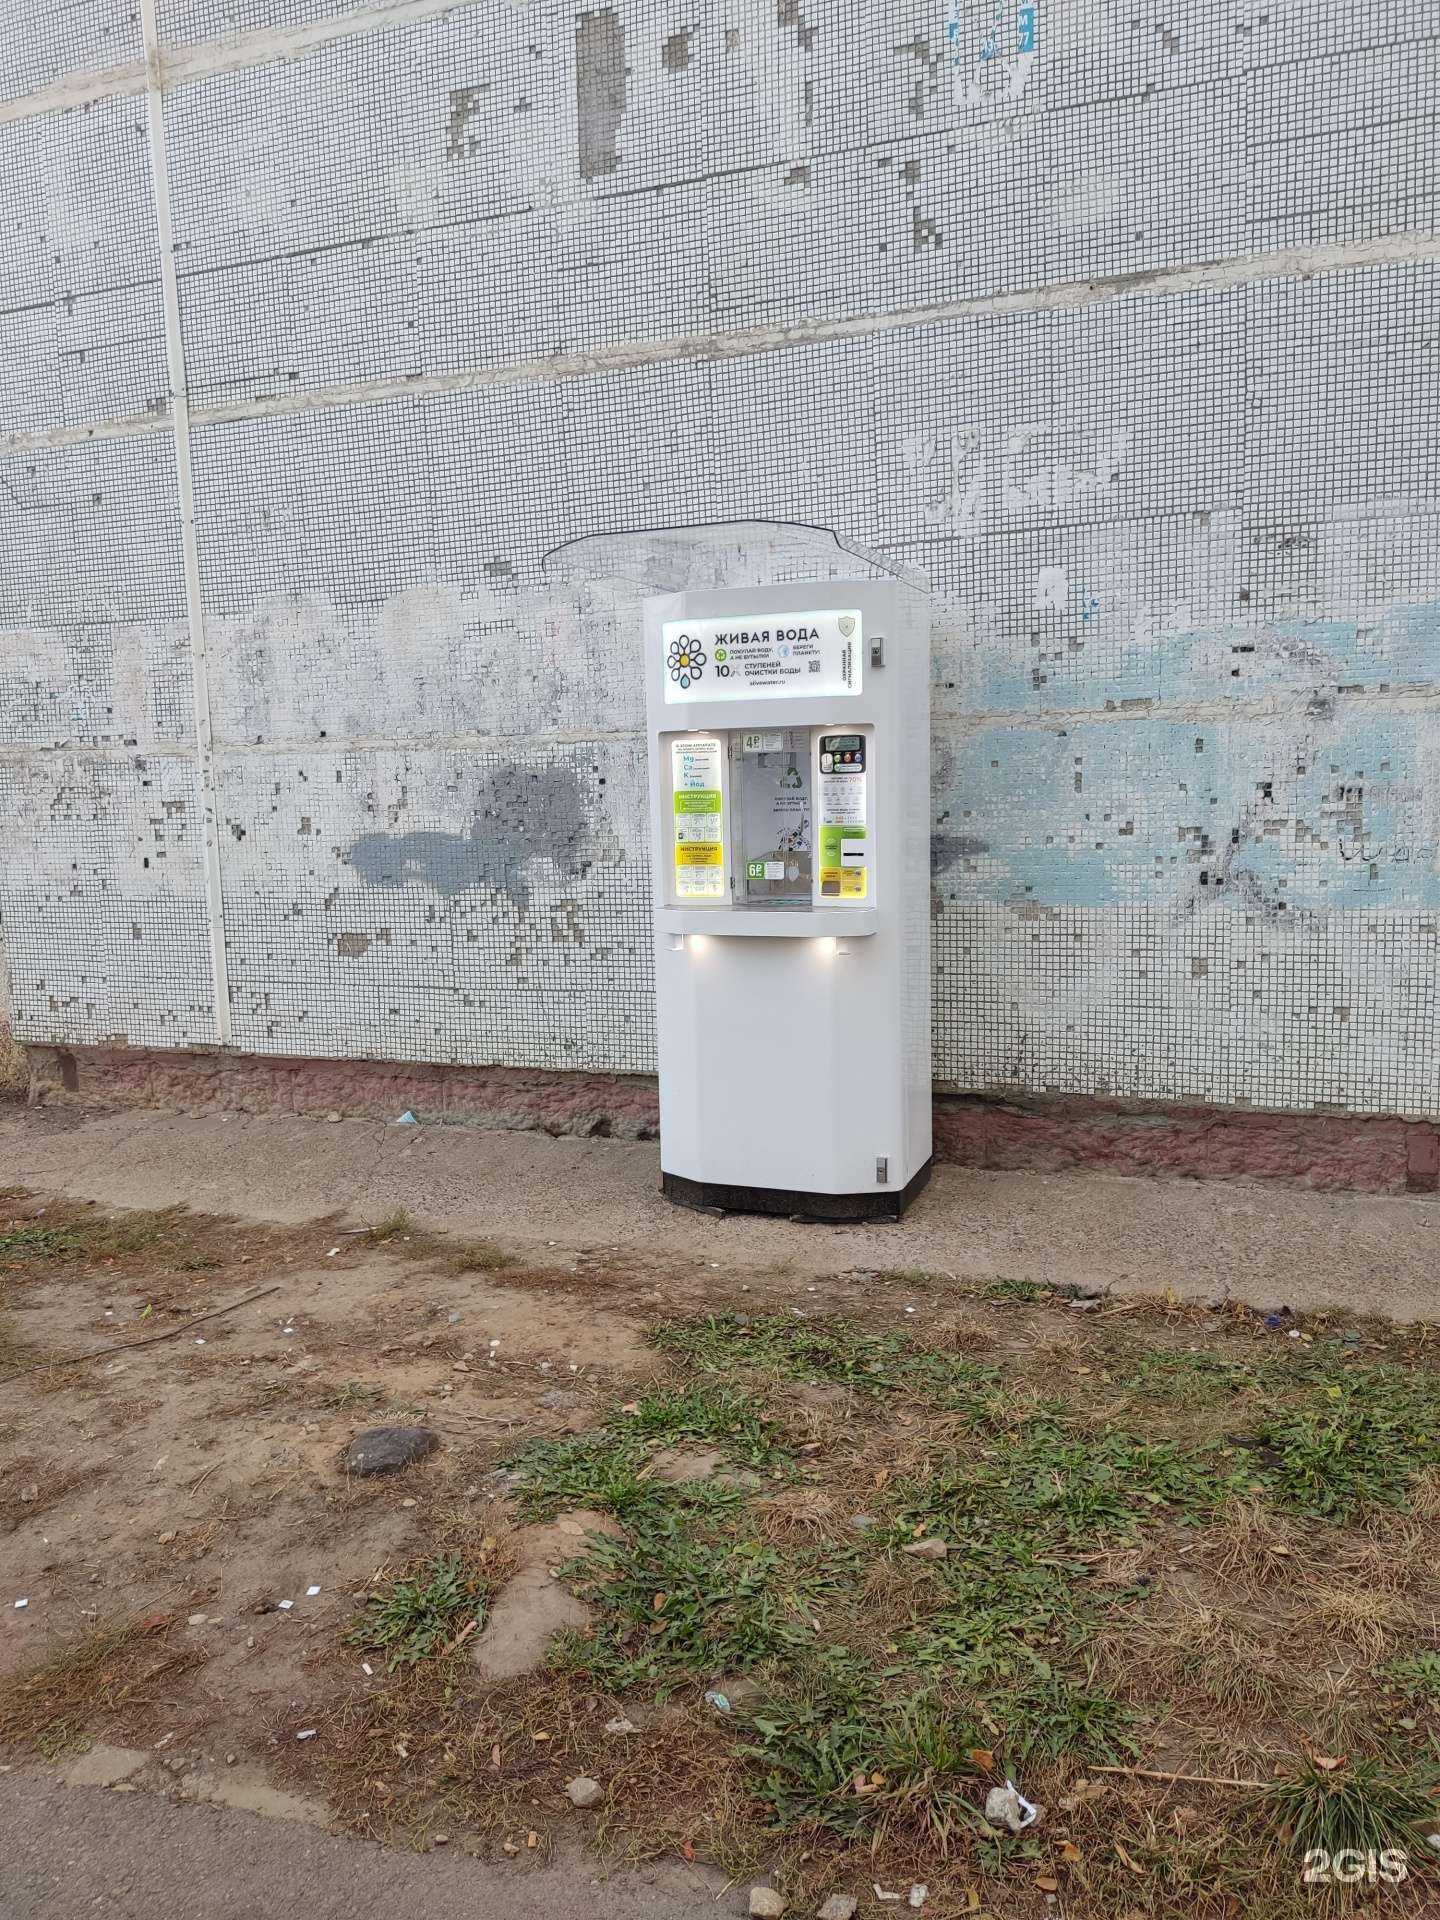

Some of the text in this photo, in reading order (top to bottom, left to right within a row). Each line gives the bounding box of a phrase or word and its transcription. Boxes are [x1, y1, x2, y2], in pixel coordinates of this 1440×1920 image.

[714, 627, 820, 645] ЖИВАЯ ВОДА
[744, 660, 781, 670] СТУПЕНЕЙ
[715, 665, 730, 678] 10
[744, 667, 801, 676] ОЧИСТКИ ВОДЫ
